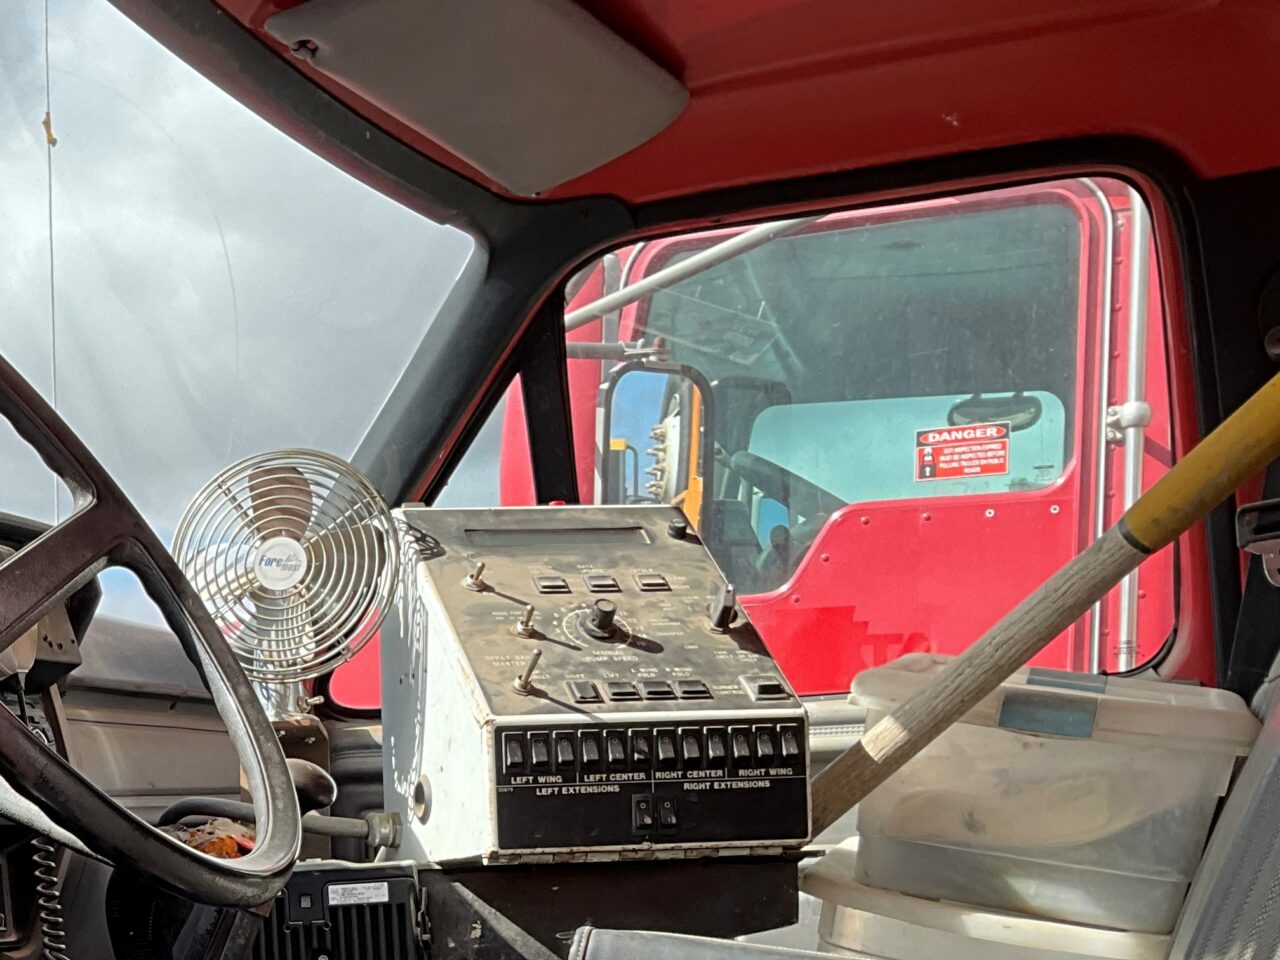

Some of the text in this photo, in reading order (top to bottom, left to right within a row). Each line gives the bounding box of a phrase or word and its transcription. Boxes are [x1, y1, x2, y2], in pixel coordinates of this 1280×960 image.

[928, 427, 998, 443] DANGER
[584, 772, 646, 782] LEFT CENTER
[655, 770, 724, 779] RIGHT CENTER
[739, 767, 793, 777] RIGHT WING
[511, 775, 563, 784] LEFT WING
[536, 785, 620, 795] LEFT EXTENSIONS
[684, 780, 770, 790] RIGHT EXTENSIONS
